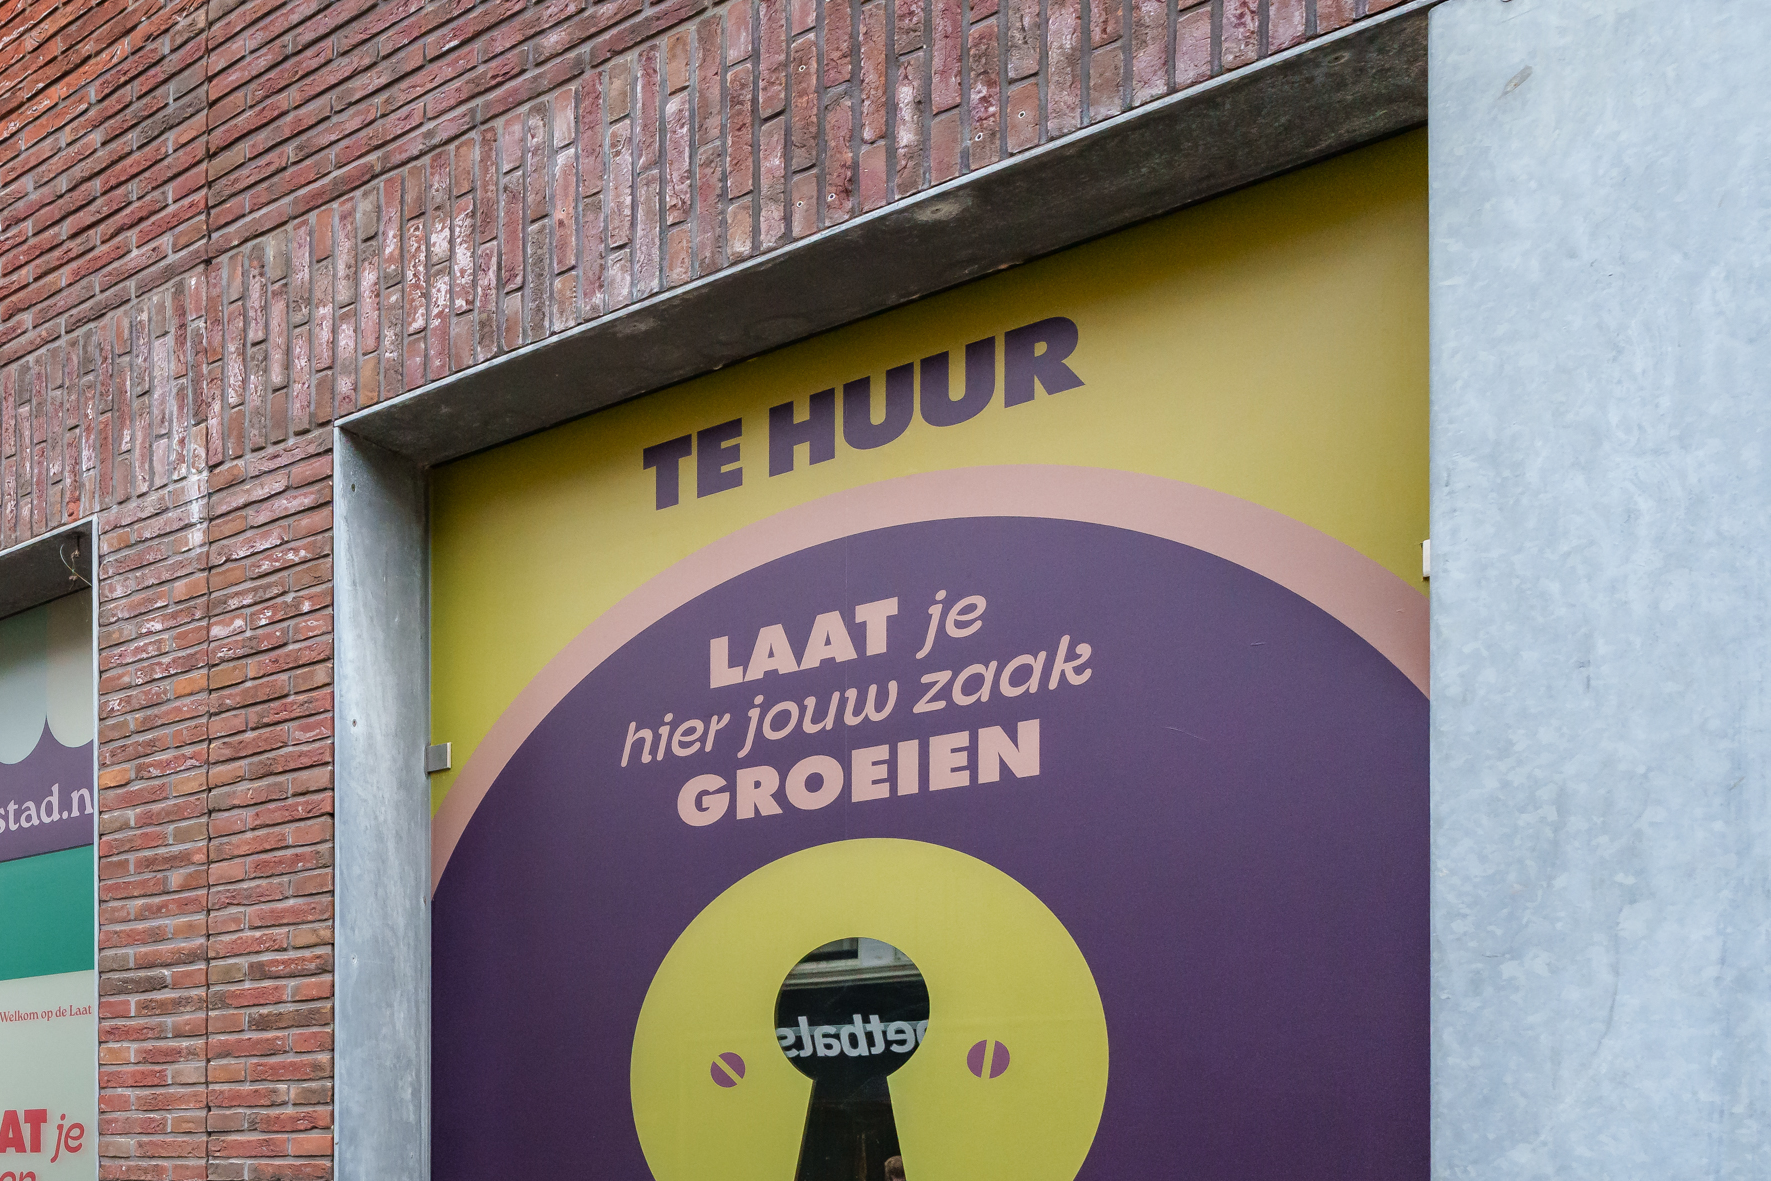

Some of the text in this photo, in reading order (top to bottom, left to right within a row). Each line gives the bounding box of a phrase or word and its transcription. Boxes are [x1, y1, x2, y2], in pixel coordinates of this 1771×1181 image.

[643, 316, 1086, 511] TE HUUR
[709, 589, 987, 689] LAAT je
[620, 634, 1092, 767] hier jouw zaak
[677, 718, 1040, 827] GROEIEN
[0, 1004, 92, 1022] Welkom op de Laat
[50, 1113, 85, 1163] je
